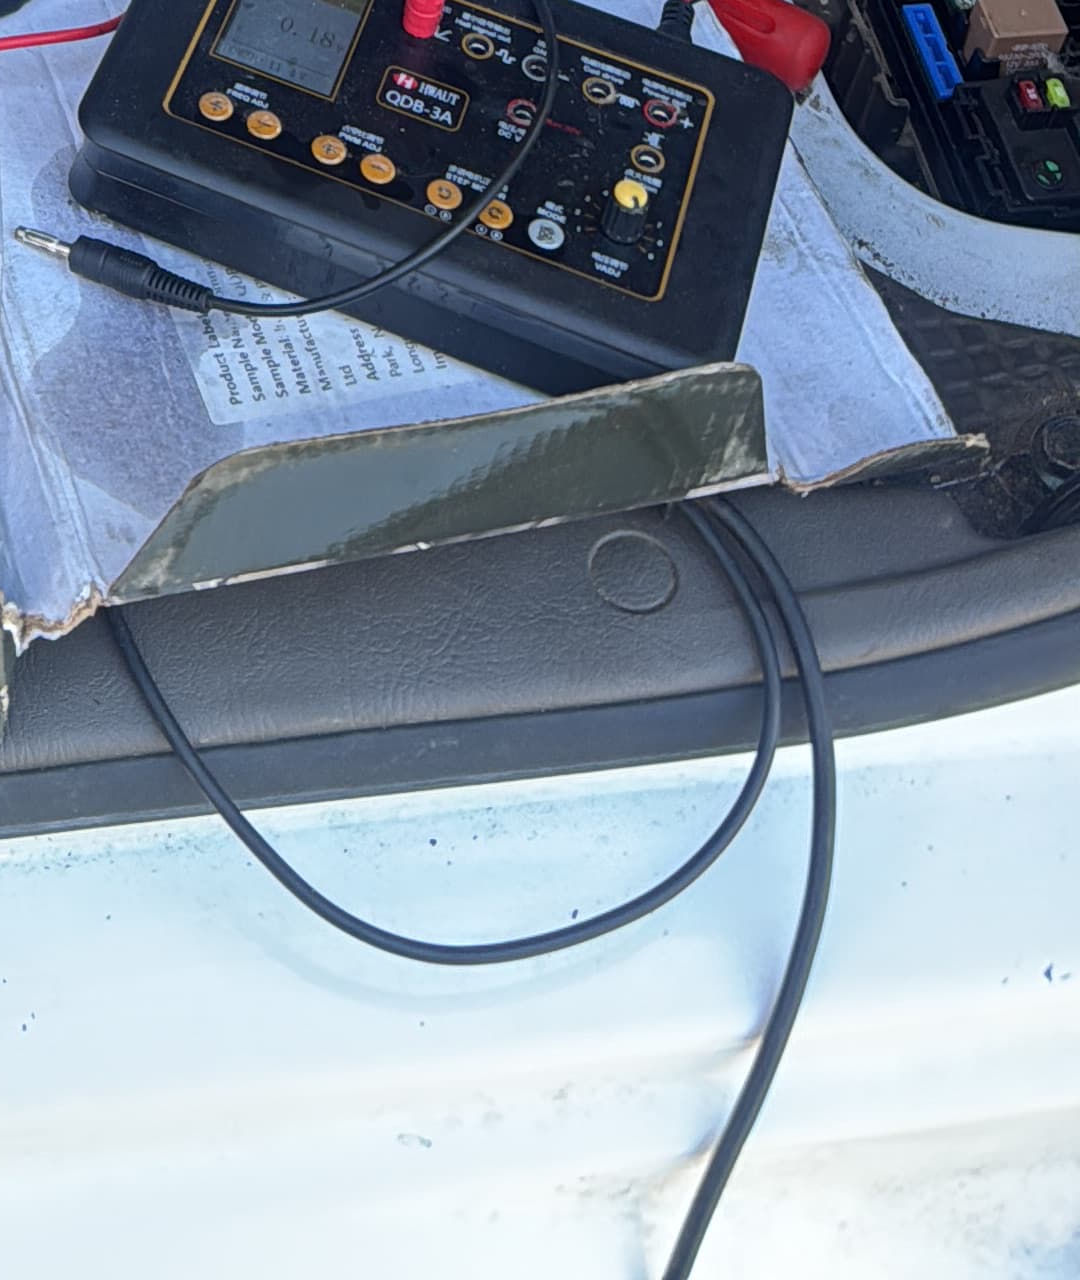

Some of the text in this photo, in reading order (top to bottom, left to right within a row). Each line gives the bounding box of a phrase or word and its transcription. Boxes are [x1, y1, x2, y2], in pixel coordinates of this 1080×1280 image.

[385, 90, 453, 125] QDB-3A
[213, 352, 243, 406] Product
[238, 351, 266, 403] Sample
[261, 340, 289, 399] Sample
[350, 326, 379, 382] Address
